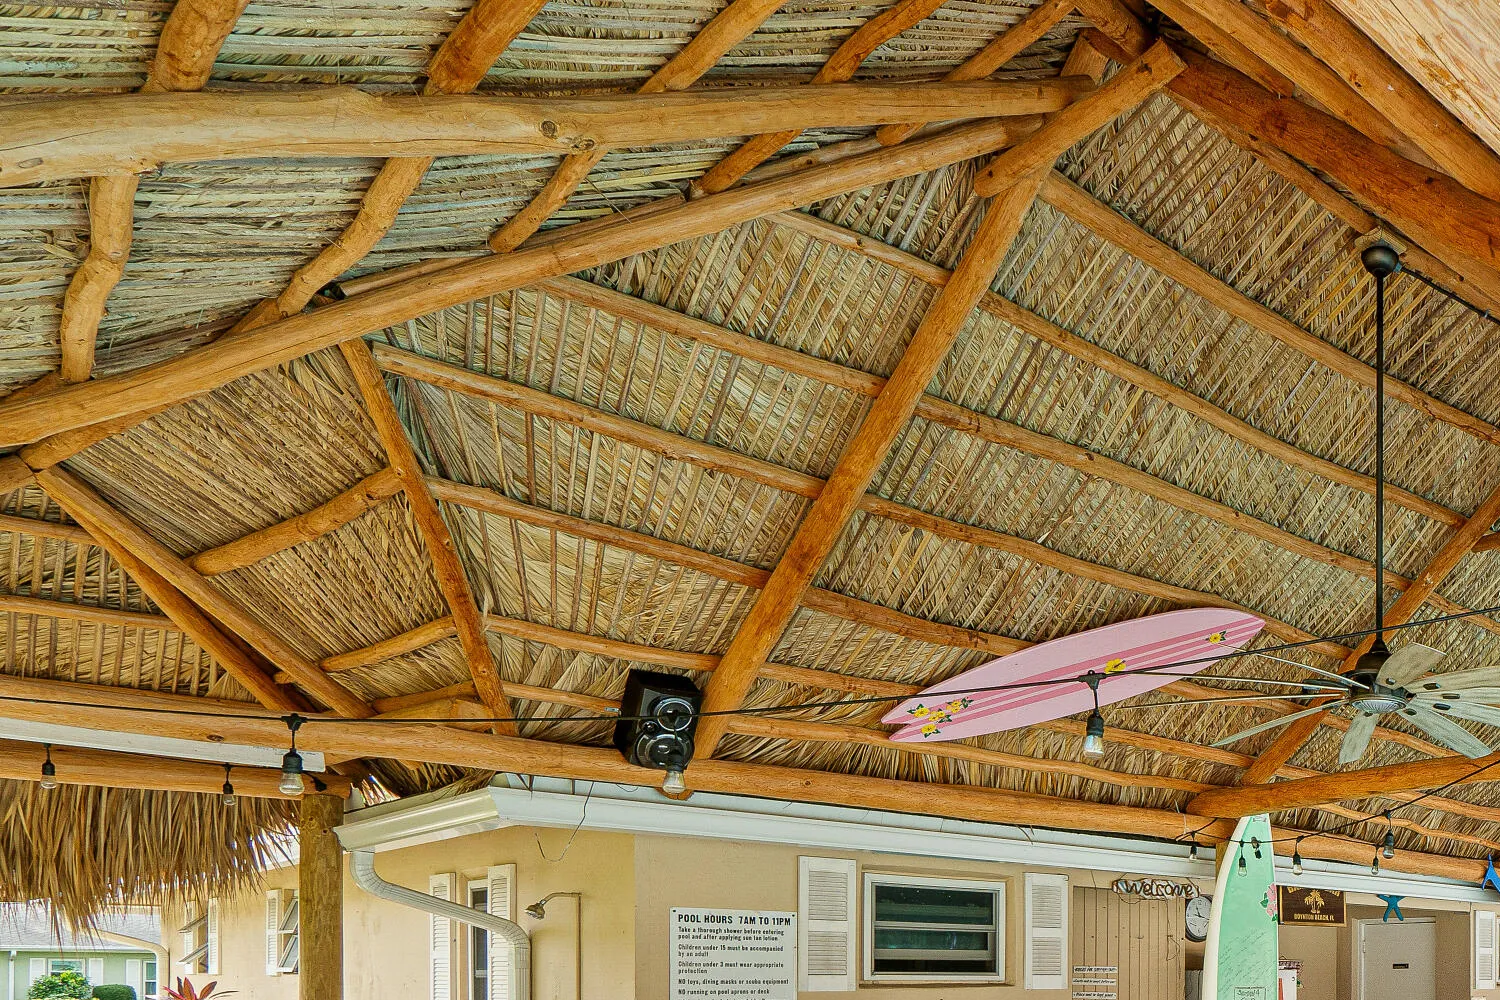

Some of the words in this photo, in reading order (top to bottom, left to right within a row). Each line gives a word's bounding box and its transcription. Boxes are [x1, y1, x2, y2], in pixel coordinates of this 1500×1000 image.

[678, 914, 701, 923] POOL
[704, 915, 733, 924] HOURS
[739, 916, 756, 925] 7AM
[759, 916, 769, 925] TO
[772, 917, 791, 926] 11PM
